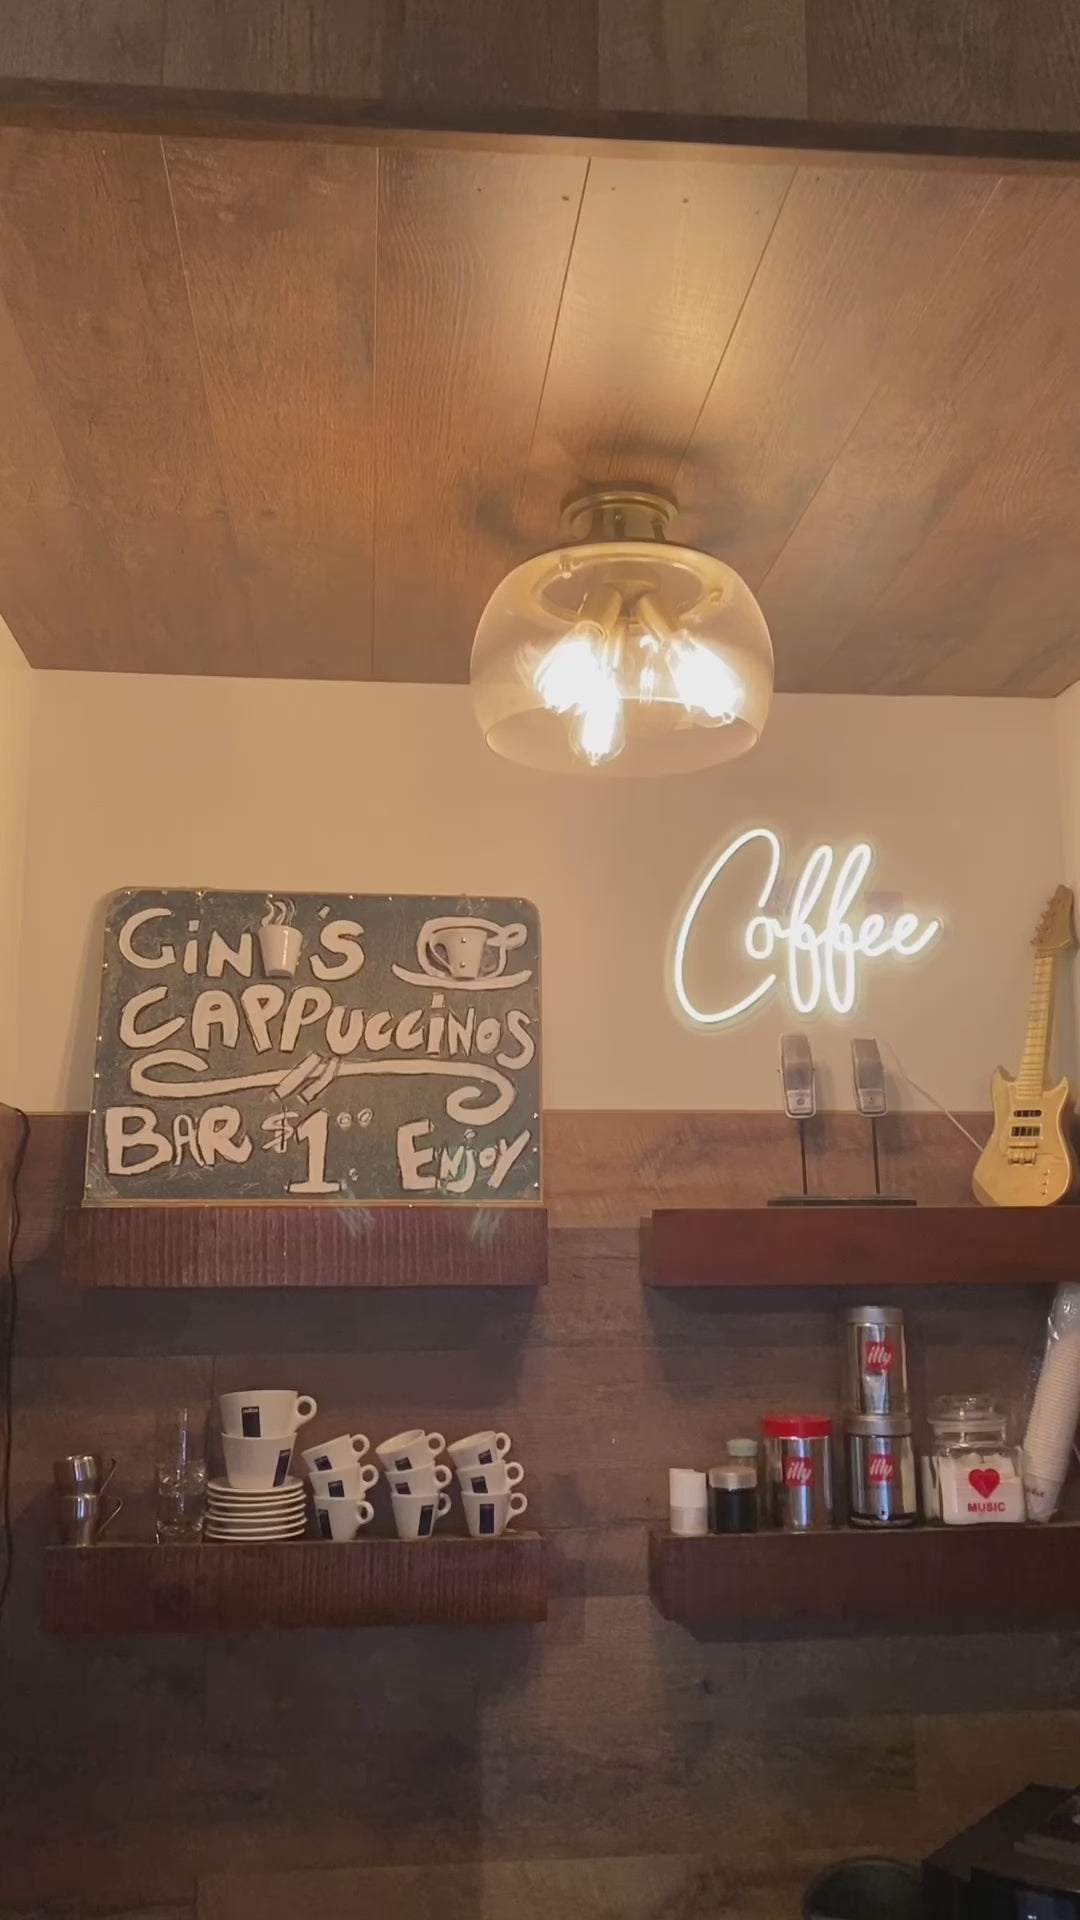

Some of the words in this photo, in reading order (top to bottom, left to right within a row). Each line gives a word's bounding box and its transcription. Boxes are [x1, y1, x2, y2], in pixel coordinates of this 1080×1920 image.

[675, 828, 939, 1023] Coffee
[105, 1104, 253, 1175] BAR
[867, 1345, 892, 1368] illy
[786, 1461, 812, 1481] illy
[869, 1458, 893, 1479] illy
[967, 1502, 1006, 1512] MUSIC
